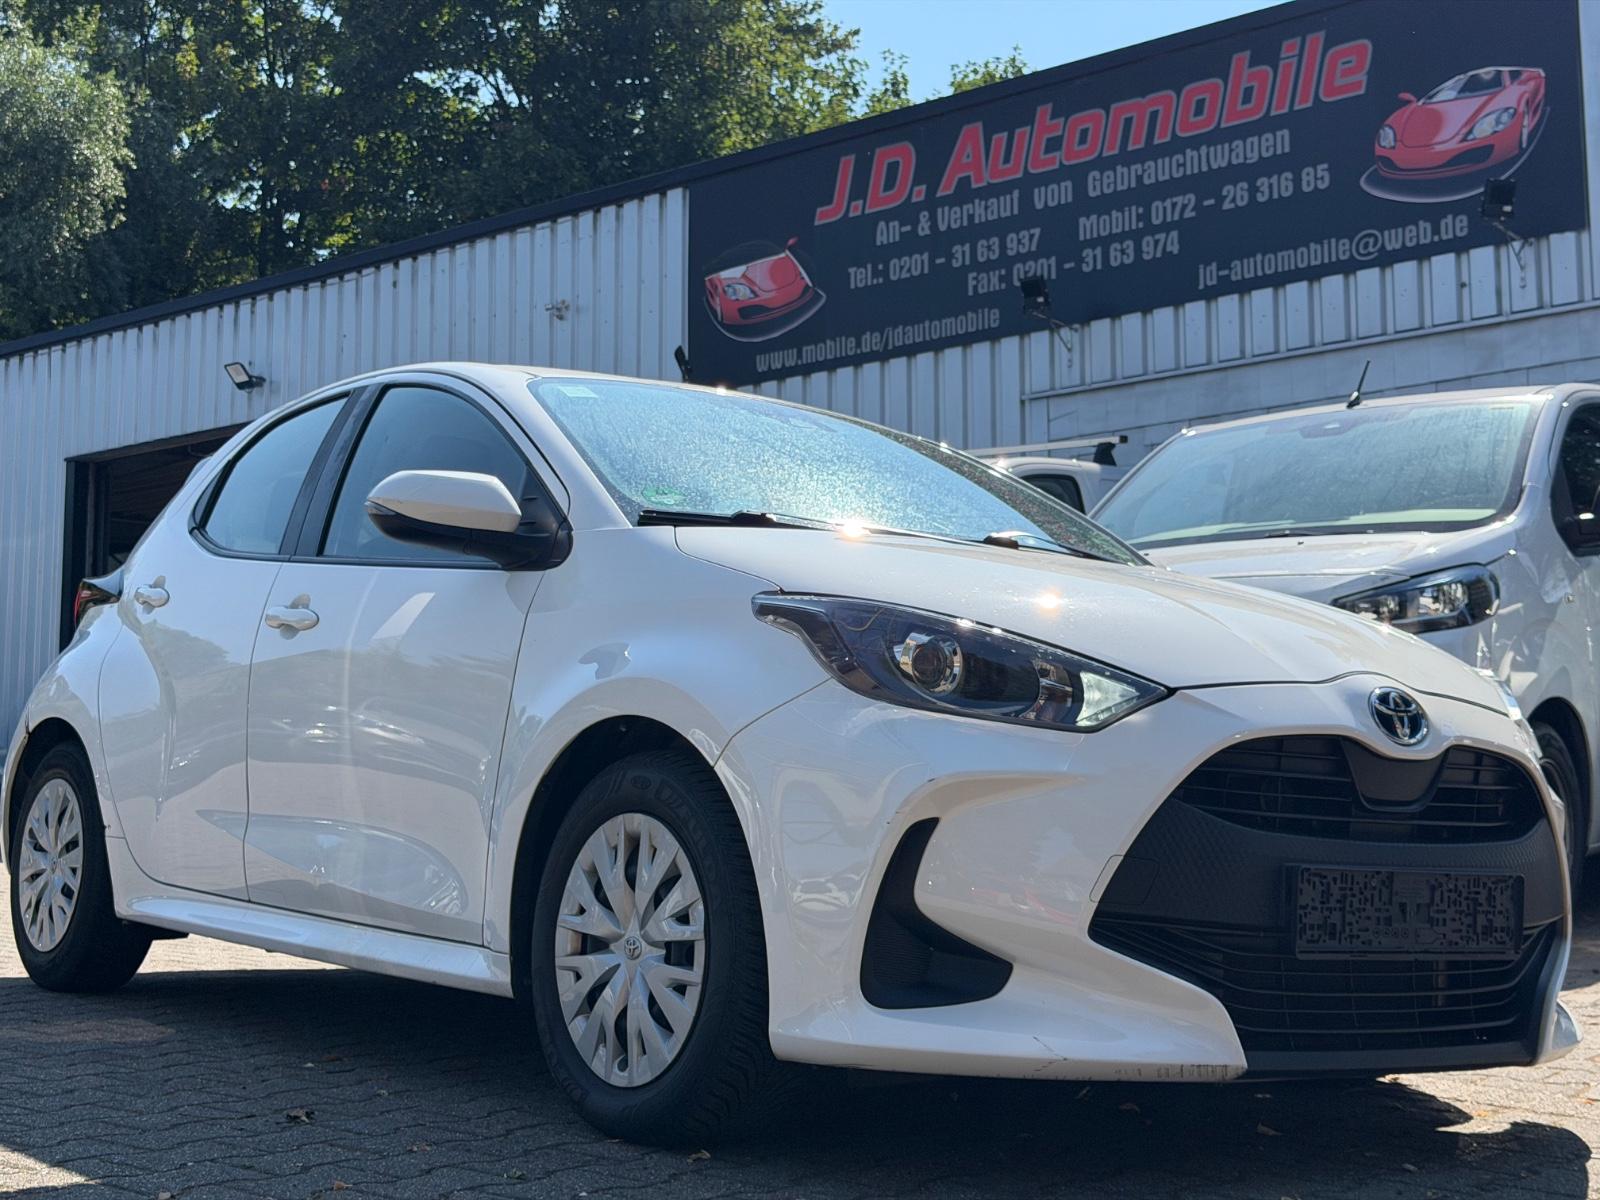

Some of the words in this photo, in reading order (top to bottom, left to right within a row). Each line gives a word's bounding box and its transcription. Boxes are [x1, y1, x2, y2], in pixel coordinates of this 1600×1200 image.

[814, 141, 925, 225] J.D.
[936, 30, 1373, 197] Automobile
[876, 220, 912, 246] An-
[917, 211, 931, 236] &
[937, 189, 1020, 232] Verkauf
[1033, 180, 1073, 210] von
[1087, 129, 1290, 198] Gebrauchtwagen
[1078, 206, 1144, 241] Mobil:
[1150, 193, 1196, 225] 0172
[1221, 182, 1249, 210] 26
[1255, 172, 1293, 202] 316
[1301, 163, 1330, 192] 85
[848, 263, 883, 289] Tel.:
[889, 252, 929, 281] 0201
[952, 243, 970, 268] 31
[976, 237, 999, 263] 63
[1006, 227, 1041, 256] 937
[968, 268, 1006, 296] Fax:
[1081, 246, 1102, 273] 31
[1109, 240, 1134, 267] 63
[1141, 230, 1180, 260] 974
[1198, 214, 1469, 290] jd-automobile@web.de
[756, 308, 1000, 373] www.mobile.de/jdautomobile
